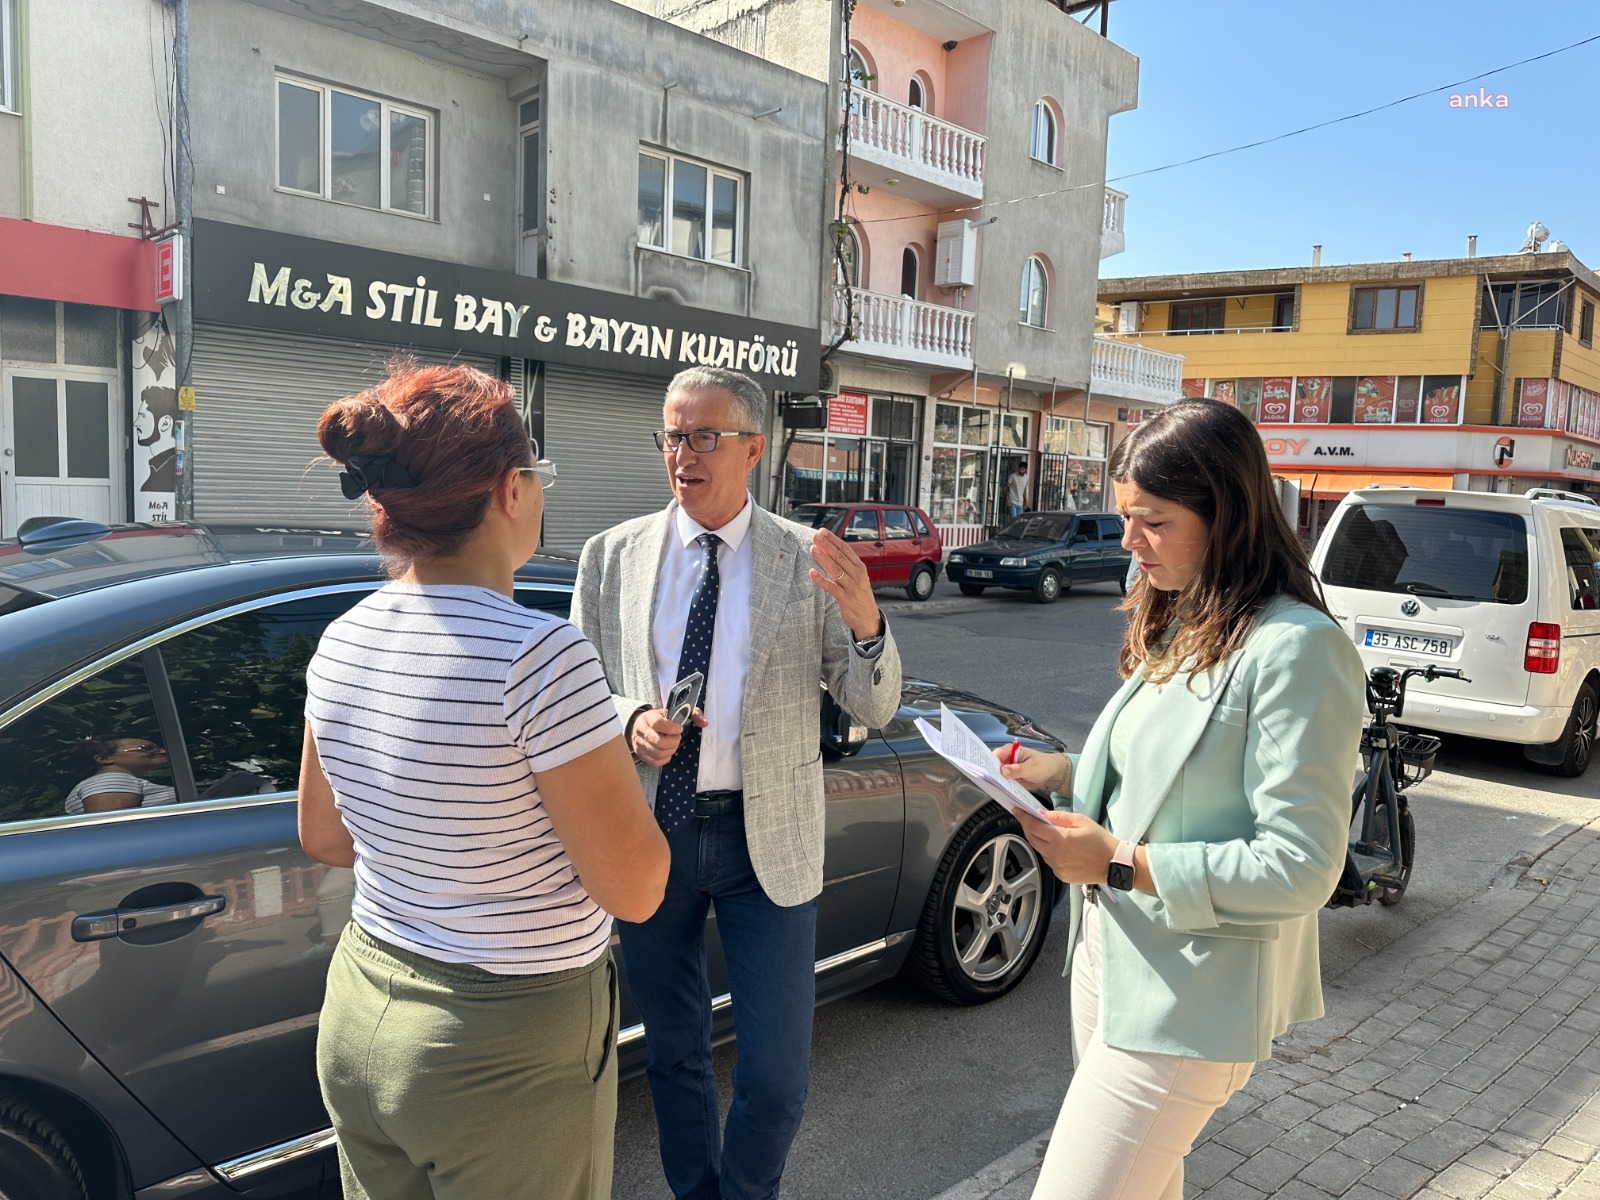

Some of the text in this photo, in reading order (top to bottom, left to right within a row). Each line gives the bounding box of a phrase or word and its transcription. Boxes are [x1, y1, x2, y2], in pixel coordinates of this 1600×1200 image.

[248, 262, 799, 377] M&A STİL BAY & BAYAN KUAFÖRÜ
[1314, 447, 1355, 456] A.V.M.
[149, 502, 168, 510] M&A
[1374, 632, 1448, 654] 35 ASC 758
